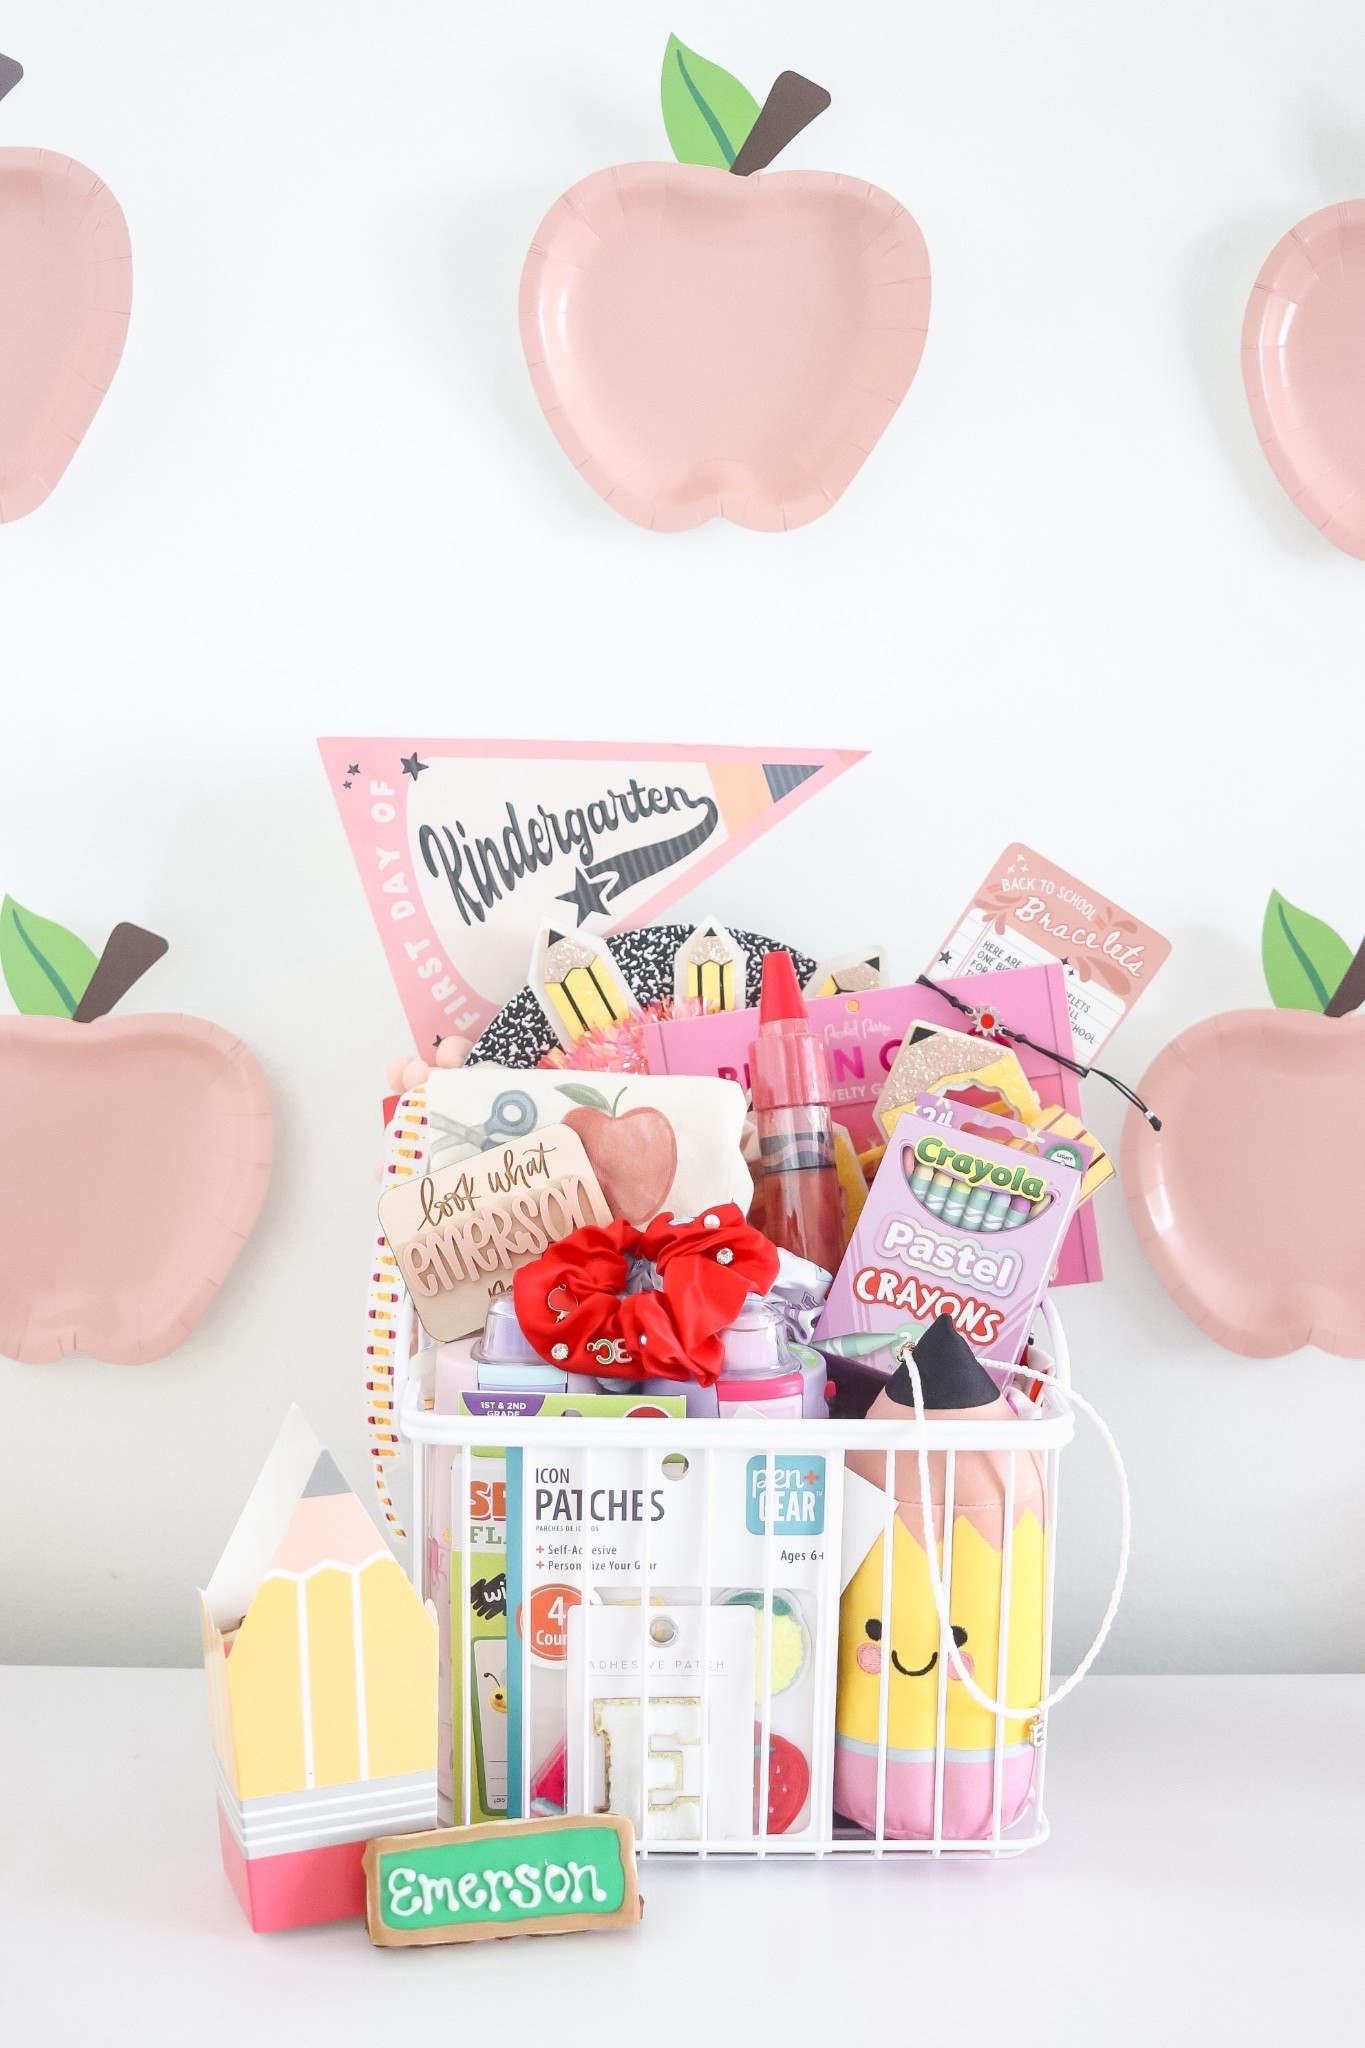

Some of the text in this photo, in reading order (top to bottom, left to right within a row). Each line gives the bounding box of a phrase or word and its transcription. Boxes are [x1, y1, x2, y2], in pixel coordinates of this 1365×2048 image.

[419, 779, 704, 927] Kindergarten
[370, 779, 481, 1031] FIRST DAY OF
[1001, 877, 1098, 922] BACK TO SCHOOL
[1014, 895, 1146, 978] Bracelets
[970, 959, 989, 973] FOR
[977, 950, 996, 966] ONE
[982, 940, 1091, 1013] HERE ARE ELETS
[917, 1136, 1046, 1200] Crayola
[1056, 1152, 1074, 1162] LIGHT
[417, 1141, 557, 1231] look what
[883, 1220, 1015, 1289] Pastel
[856, 1269, 1002, 1344] CRAYONS
[480, 1401, 527, 1410] 1ST & 2ND
[535, 1467, 571, 1484] ICON
[535, 1488, 665, 1522] PATCHES
[535, 1525, 600, 1533] PARCHES DE ICOS
[548, 1544, 618, 1556] Self-Aesive
[548, 1560, 607, 1571] Personize
[609, 1560, 632, 1571] Your
[780, 1550, 806, 1564] Ages
[547, 1596, 567, 1626] 4
[675, 1660, 725, 1670] PATH
[386, 1861, 608, 1918] Emerson
